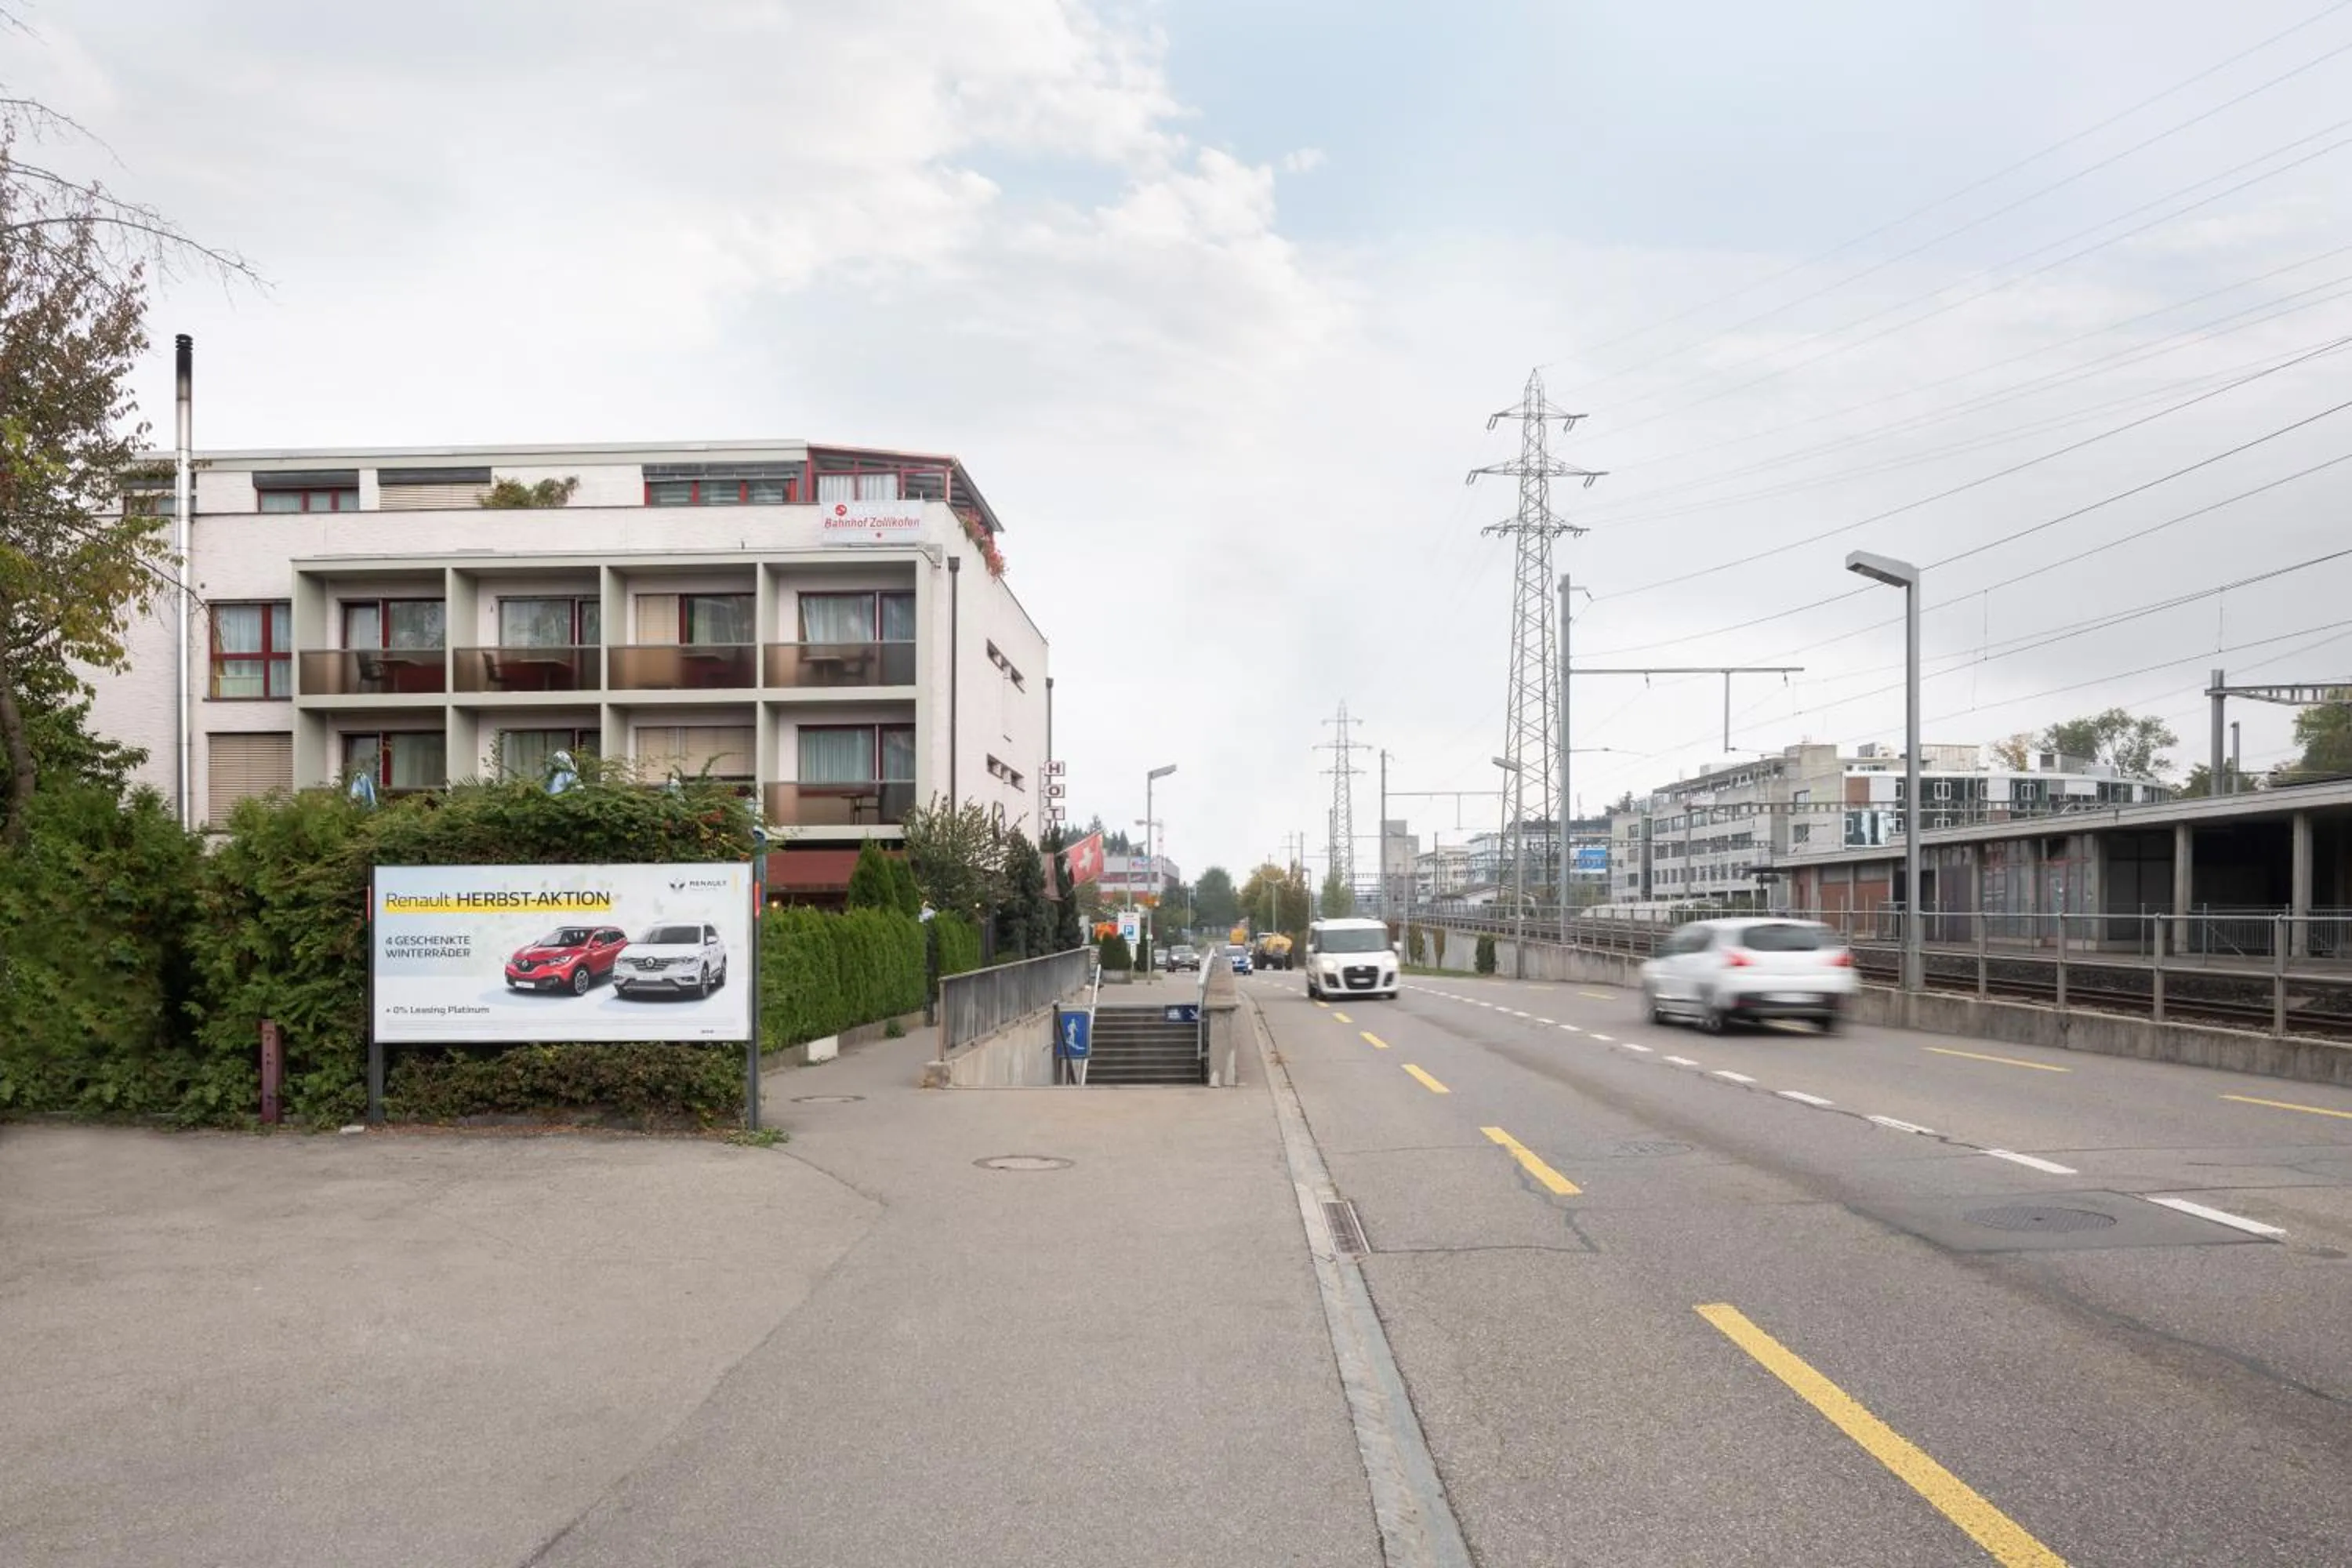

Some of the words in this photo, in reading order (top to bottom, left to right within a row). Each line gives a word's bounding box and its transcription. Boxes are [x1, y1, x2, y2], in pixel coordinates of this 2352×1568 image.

[824, 517, 868, 528] Bahnhof
[386, 891, 450, 907] Renault
[457, 891, 610, 907] HERBST-AKTION
[385, 936, 392, 945] 4
[394, 935, 470, 946] GESCHENKTE
[385, 947, 471, 958] WINTERRÄDER
[410, 1006, 445, 1016] Leasing
[448, 1005, 490, 1014] Platinum
